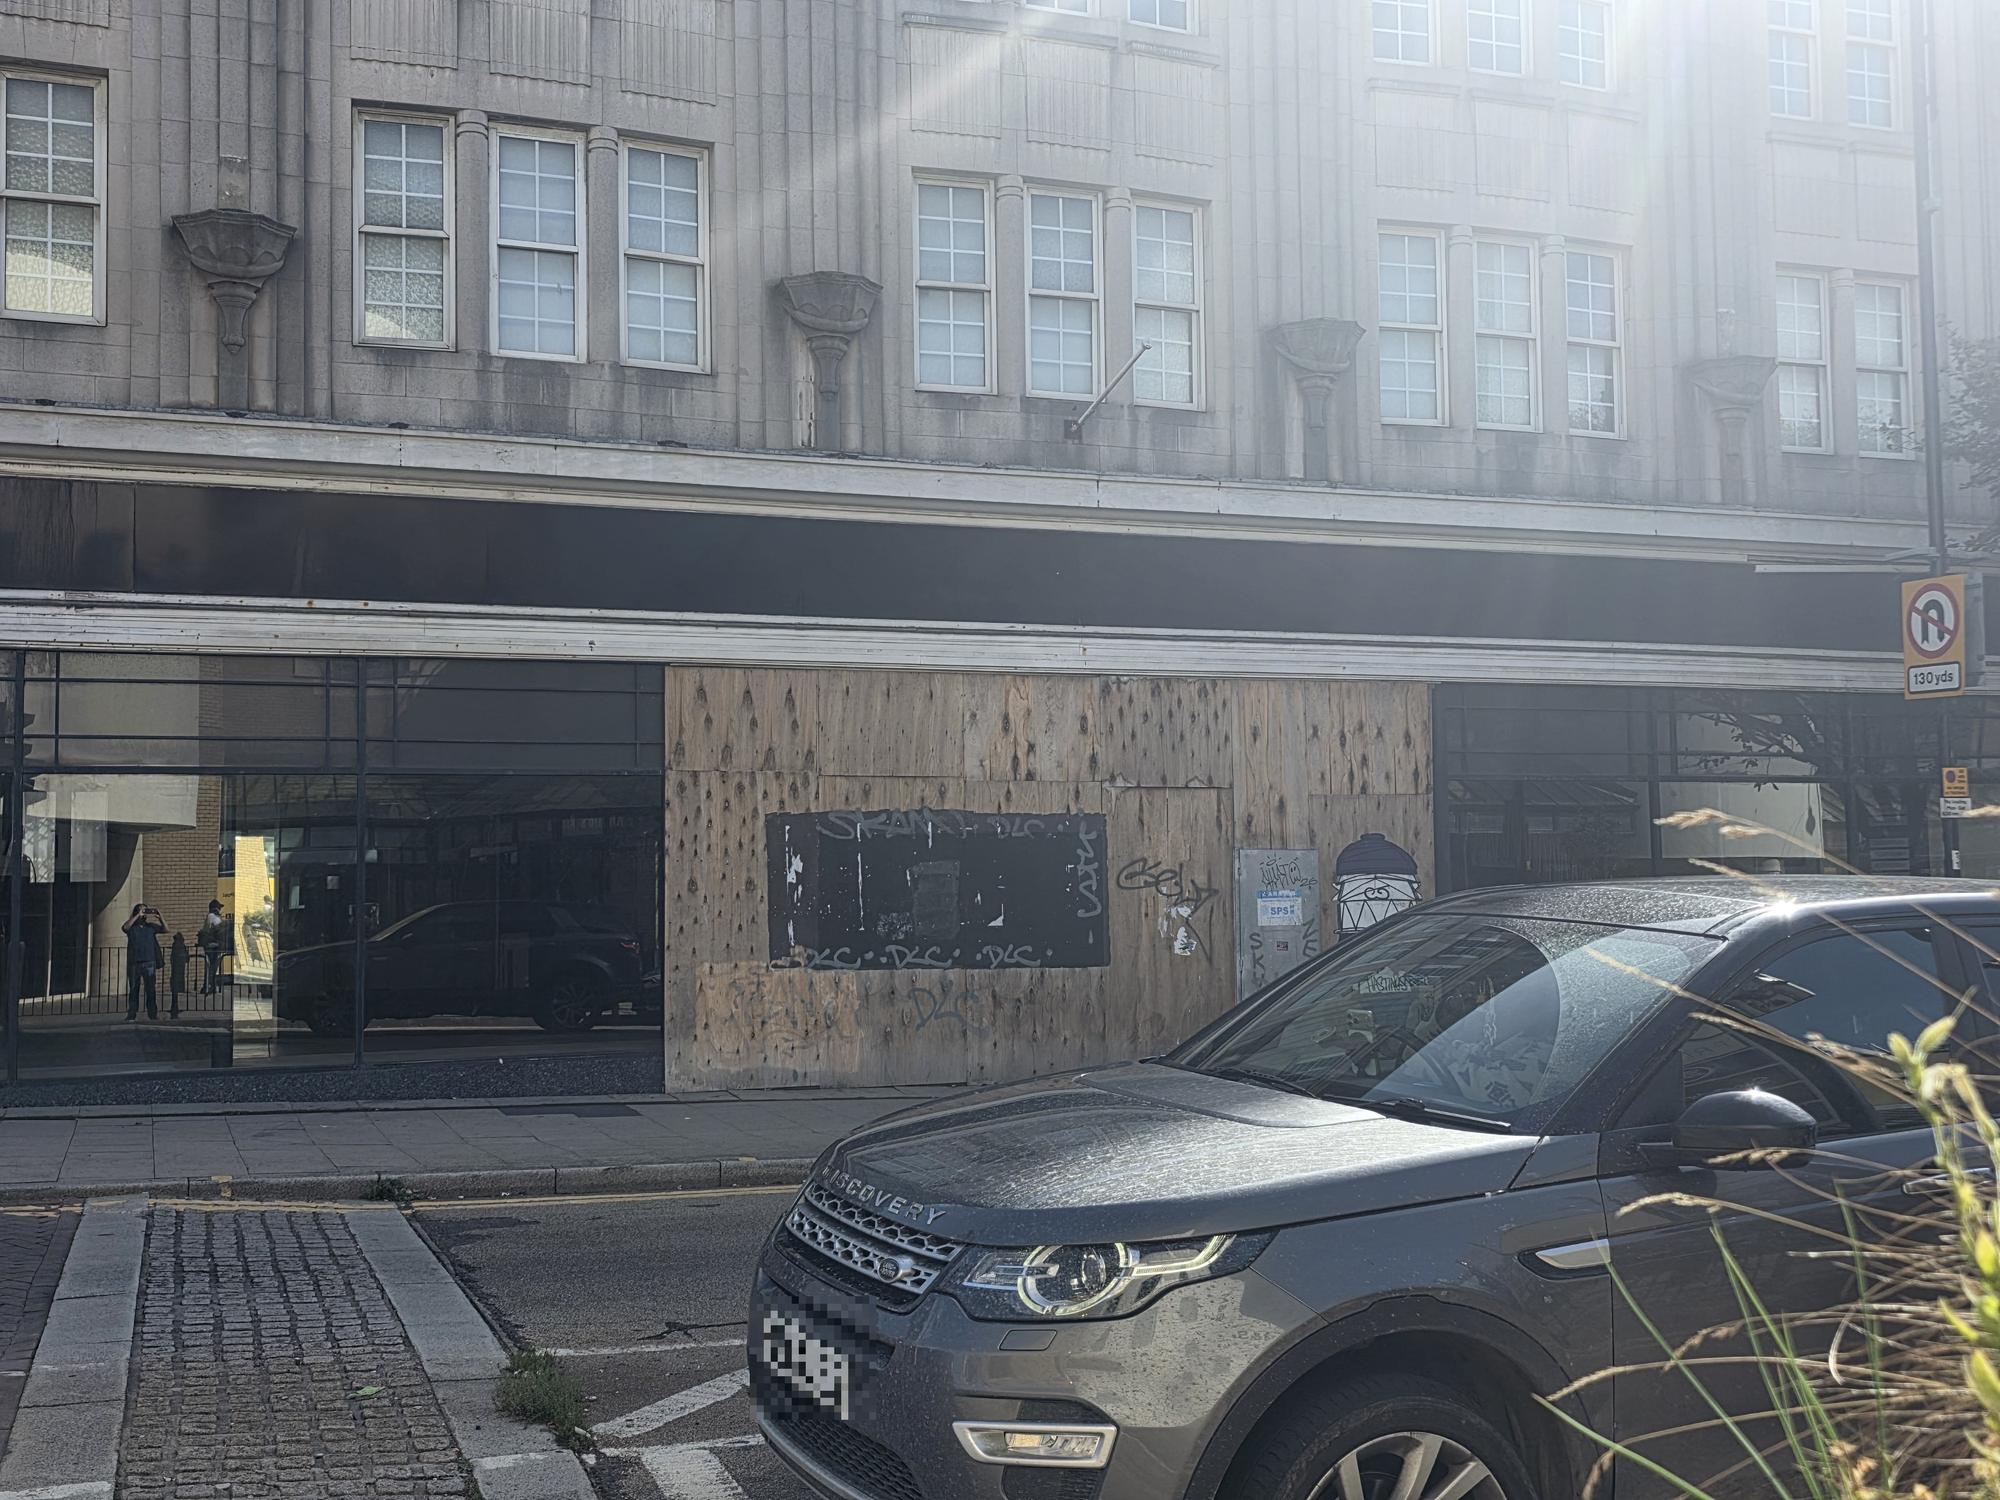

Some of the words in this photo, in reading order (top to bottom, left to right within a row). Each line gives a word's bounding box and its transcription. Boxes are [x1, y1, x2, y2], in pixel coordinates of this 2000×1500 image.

[1913, 671, 1933, 685] 130
[1934, 669, 1954, 686] yds
[1270, 906, 1289, 916] SPS
[822, 1165, 947, 1226] DISCOVERY
